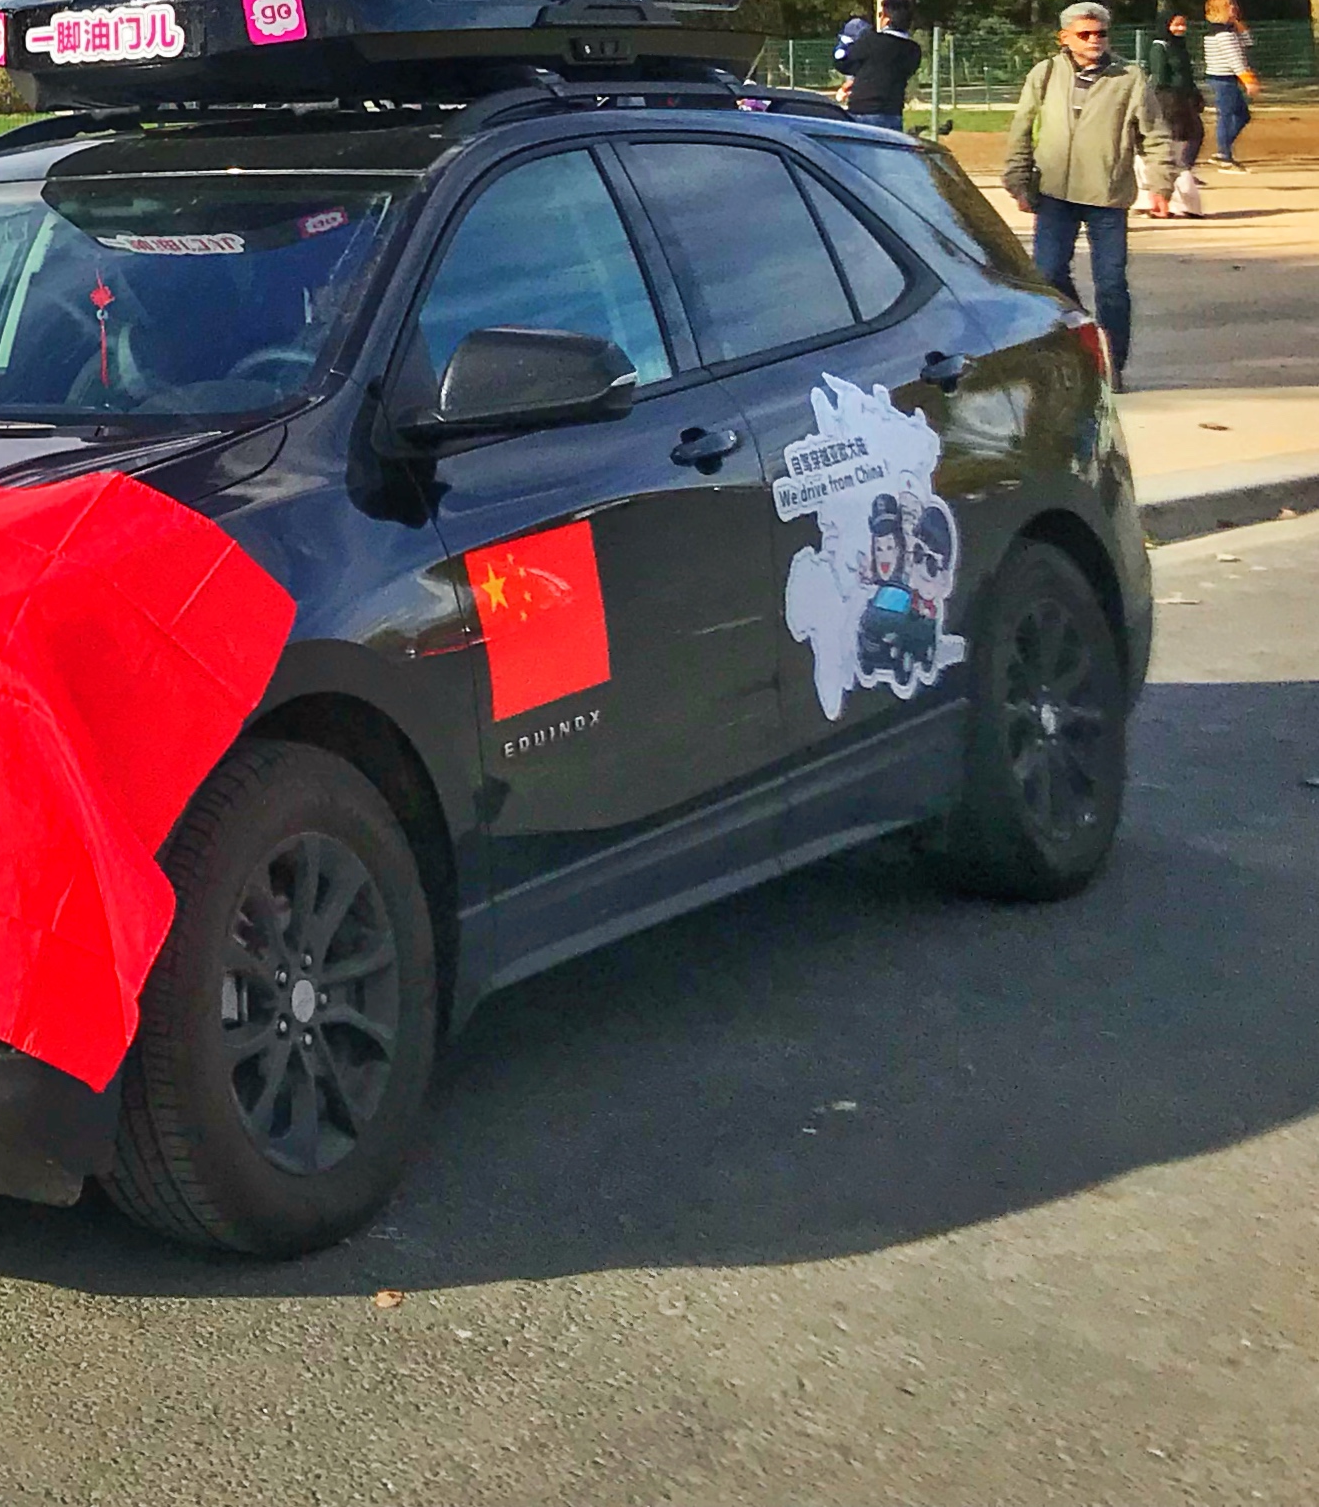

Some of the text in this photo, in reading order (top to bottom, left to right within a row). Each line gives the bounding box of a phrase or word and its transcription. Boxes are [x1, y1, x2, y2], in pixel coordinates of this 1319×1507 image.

[260, 1, 293, 26] go
[31, 12, 177, 55] 一脚油门儿
[778, 490, 798, 507] We
[801, 481, 828, 502] drive
[828, 474, 855, 492] from
[504, 710, 600, 758] EQUINOX
